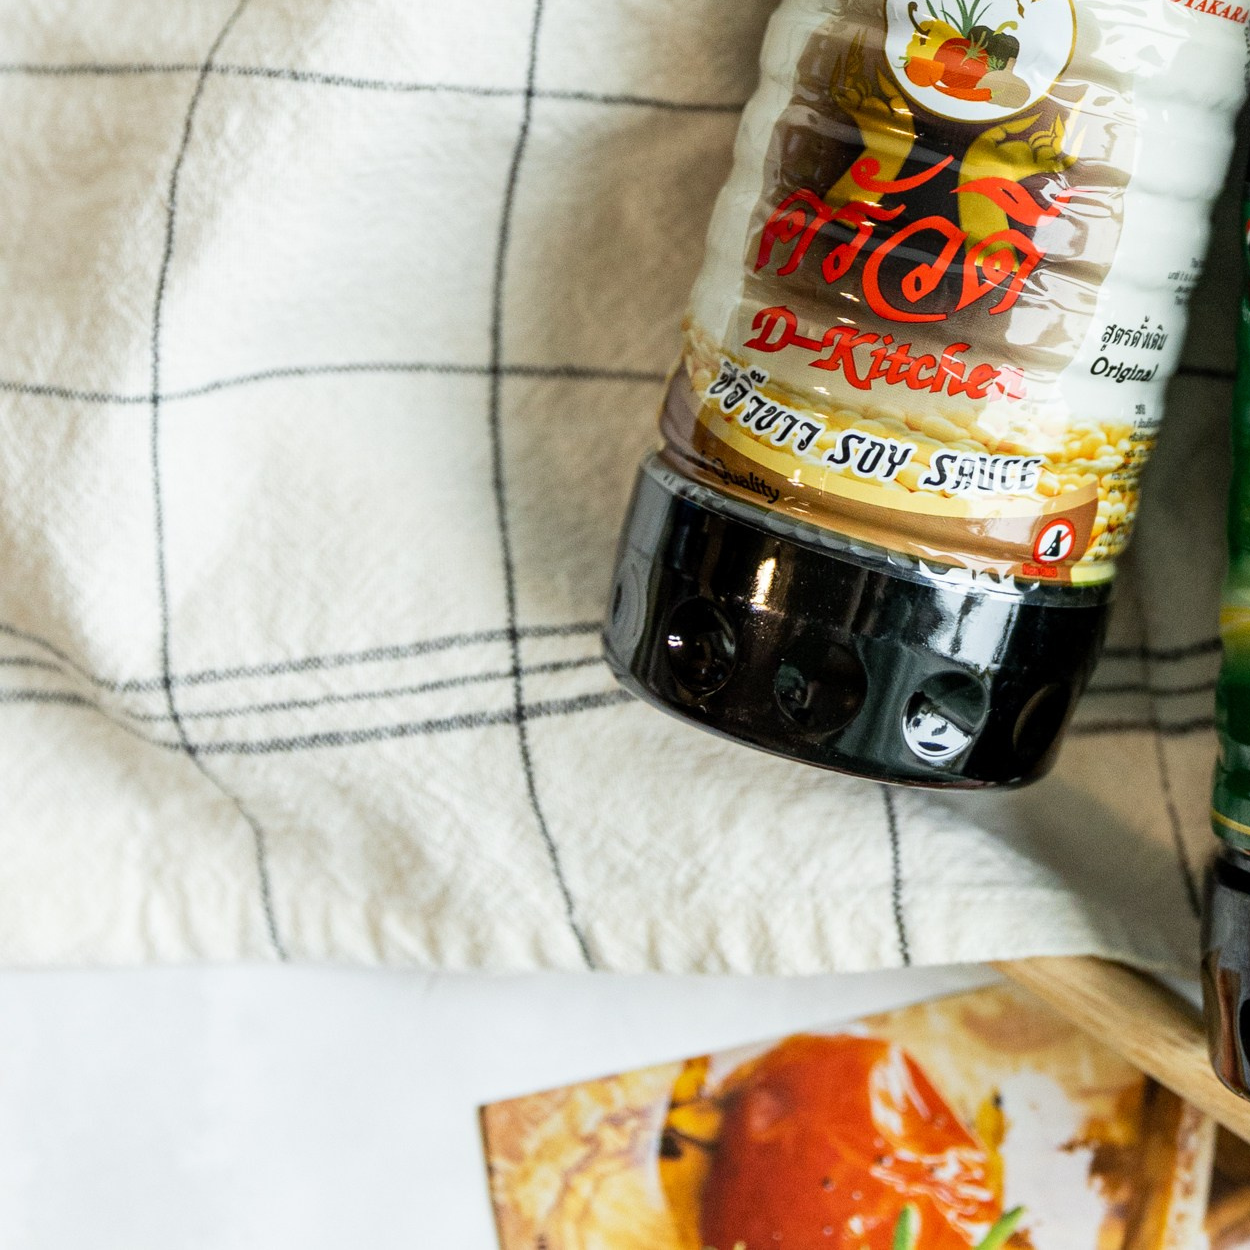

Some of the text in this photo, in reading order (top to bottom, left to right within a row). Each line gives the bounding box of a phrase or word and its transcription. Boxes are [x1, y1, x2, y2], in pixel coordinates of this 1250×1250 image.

[743, 305, 1027, 402] D-Kitchen
[1090, 356, 1160, 384] Original
[827, 434, 912, 478] SOY
[923, 454, 1044, 491] SAUCE
